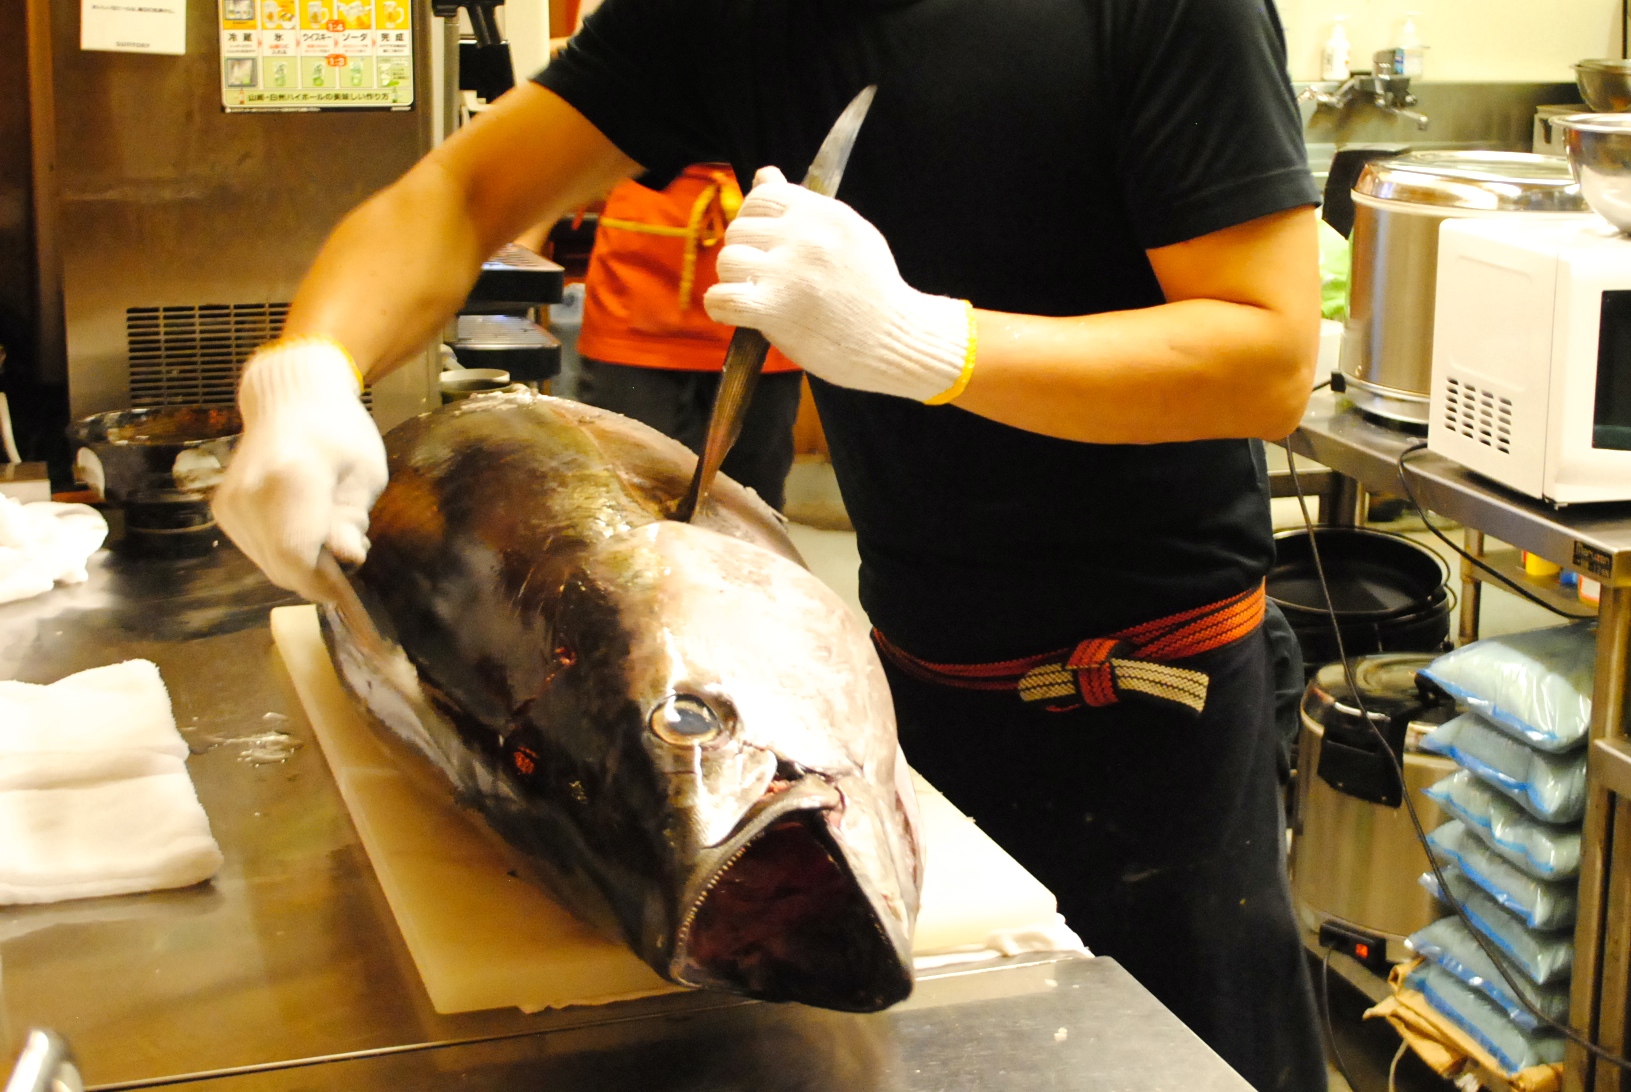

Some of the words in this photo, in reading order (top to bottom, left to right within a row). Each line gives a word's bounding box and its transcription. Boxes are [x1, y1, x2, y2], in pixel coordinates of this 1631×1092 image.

[328, 22, 344, 31] 1:4
[343, 33, 367, 41] ソーダ
[381, 33, 405, 41] 完成
[329, 58, 344, 66] 1:3
